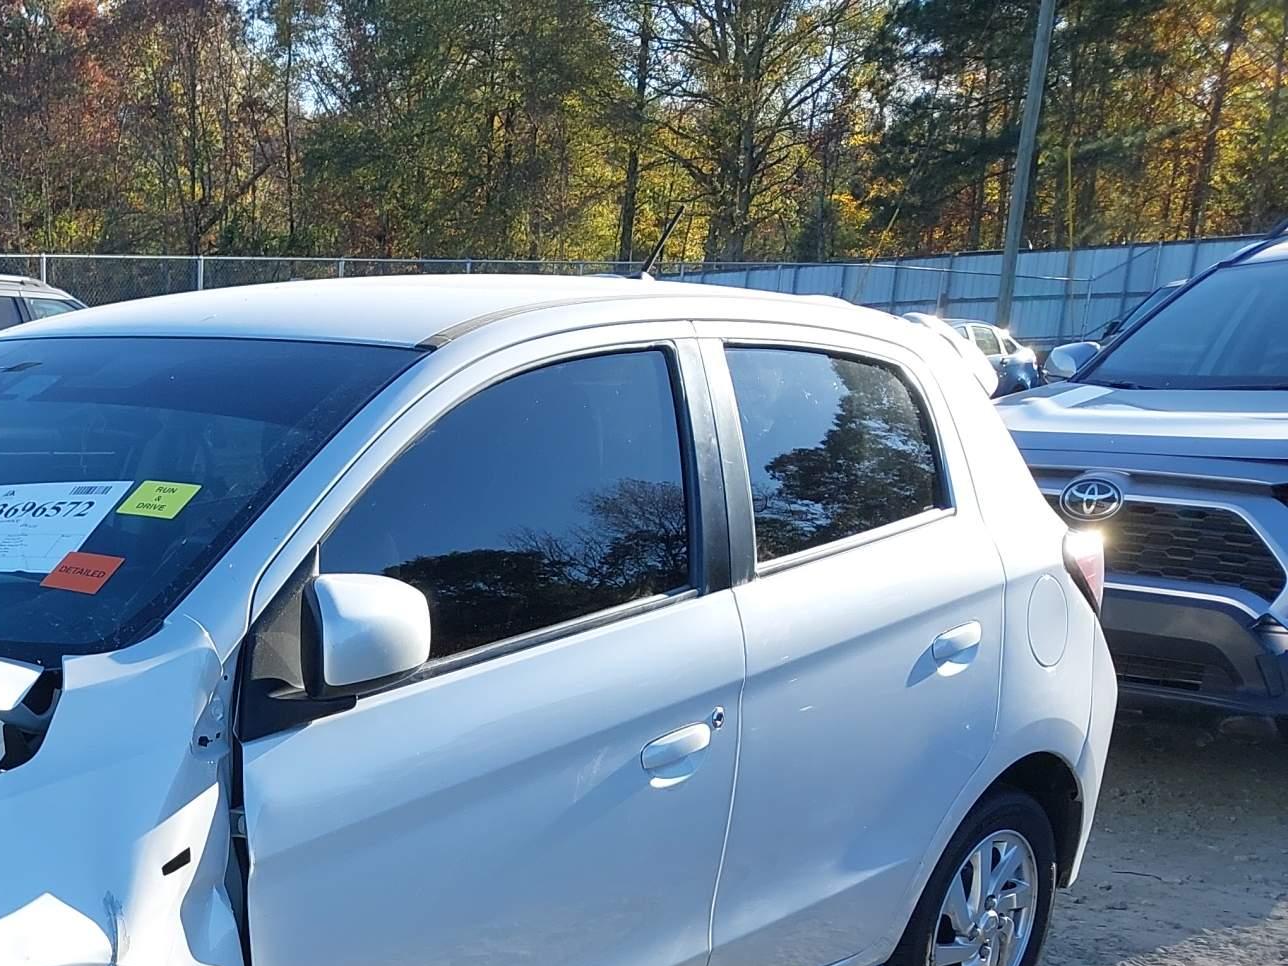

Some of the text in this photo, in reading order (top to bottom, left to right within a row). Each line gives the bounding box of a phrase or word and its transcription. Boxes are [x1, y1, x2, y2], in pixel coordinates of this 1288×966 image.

[155, 486, 178, 494] RUN
[135, 502, 167, 512] DRIVE
[59, 565, 107, 579] DETAILED
